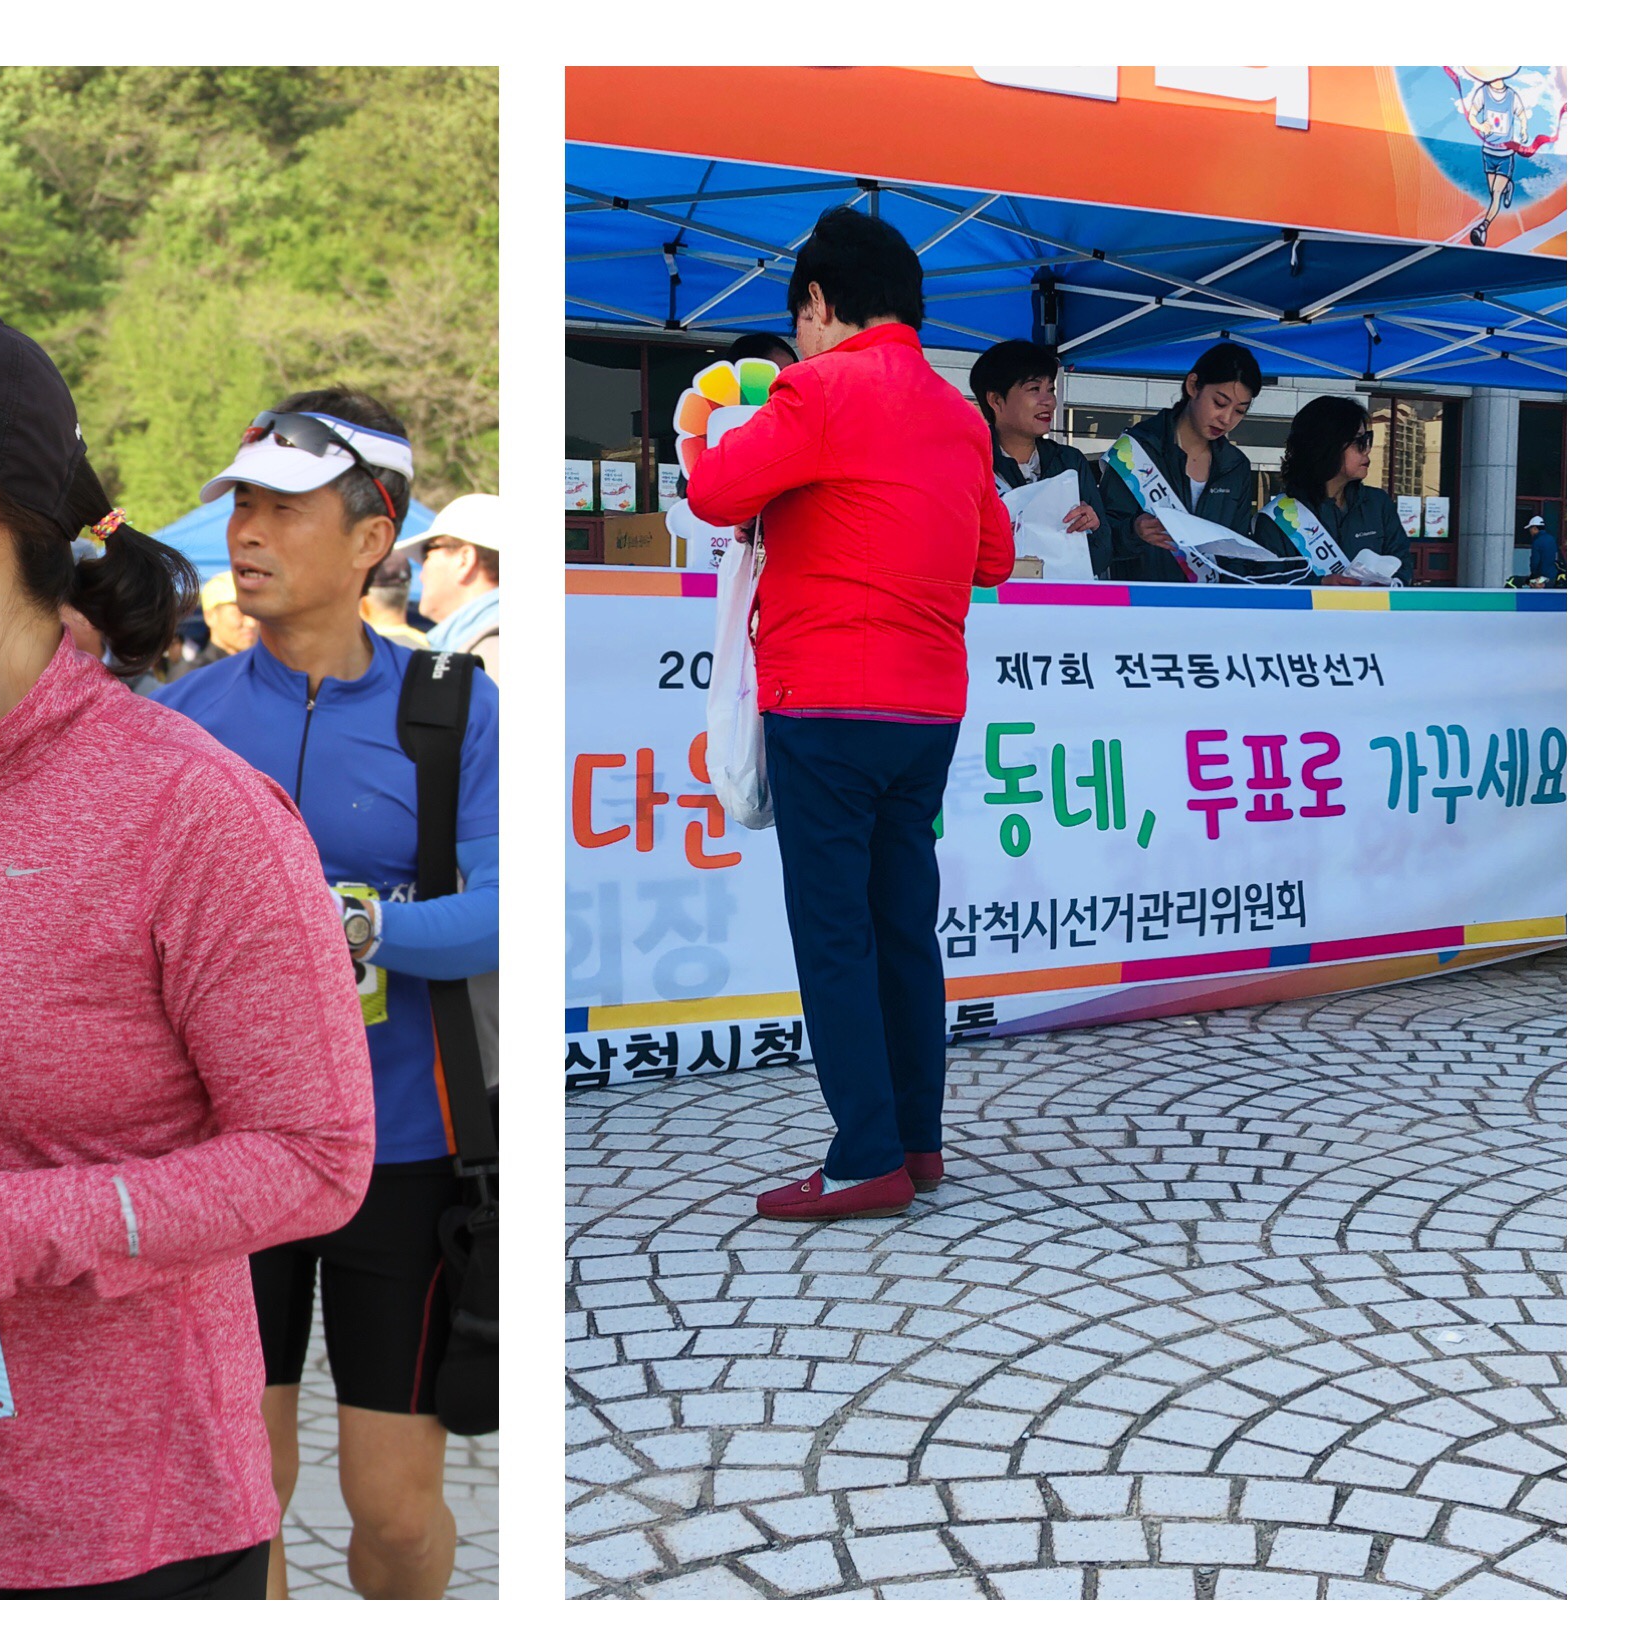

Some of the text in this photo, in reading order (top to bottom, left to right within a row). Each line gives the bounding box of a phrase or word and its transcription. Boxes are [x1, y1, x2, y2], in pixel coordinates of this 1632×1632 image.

[996, 652, 1386, 690] 제7회 전국동시지방선거
[983, 722, 1156, 858] 동네,
[1186, 730, 1346, 841] 투표로
[1370, 724, 1567, 825] 가꾸세요
[937, 880, 1307, 960] 삼척시선거관리위원회
[565, 1019, 804, 1088] 삼척시청
